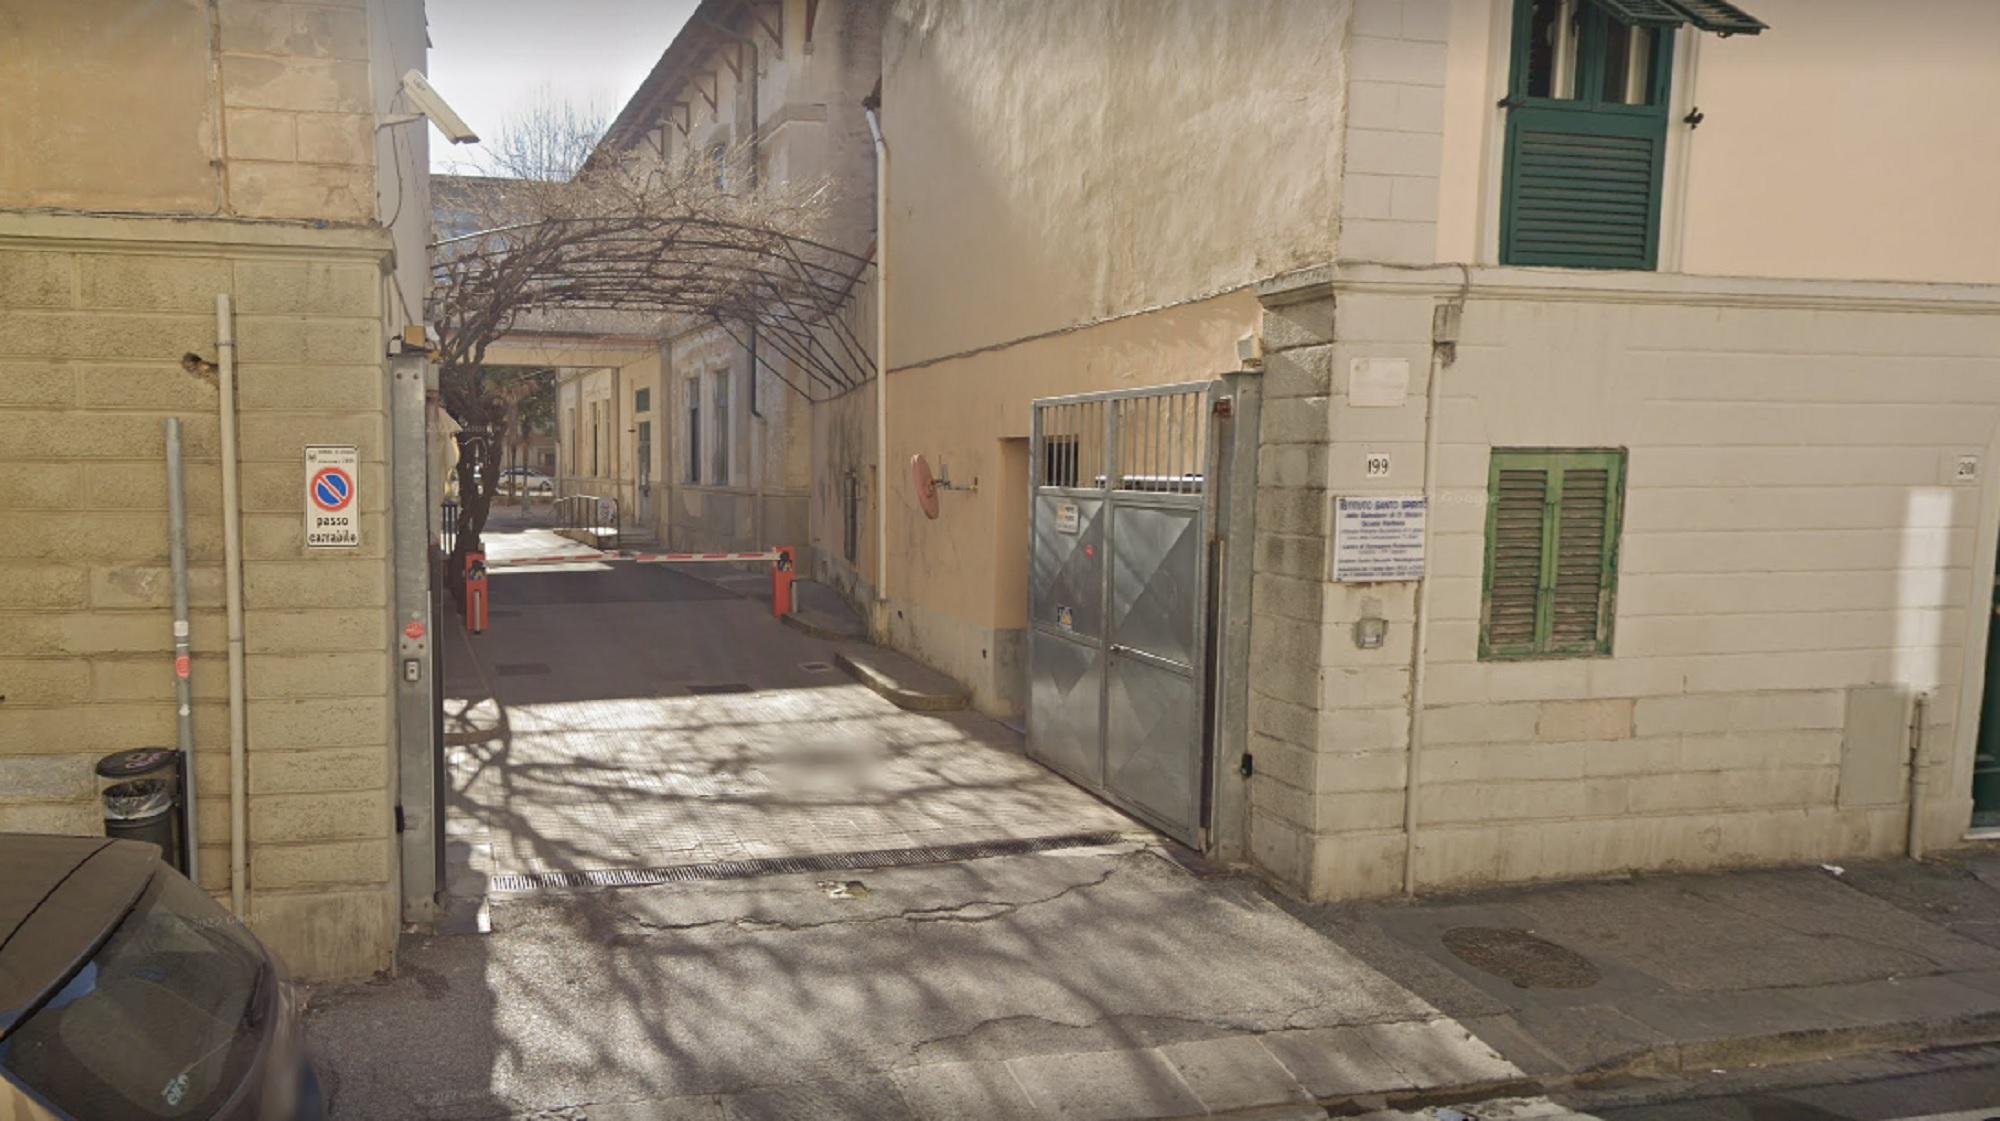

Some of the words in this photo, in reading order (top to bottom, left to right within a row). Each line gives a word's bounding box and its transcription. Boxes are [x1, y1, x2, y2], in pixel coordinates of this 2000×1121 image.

[1368, 458, 1388, 474] 199
[1375, 500, 1399, 510] SANTO
[316, 517, 349, 528] passo
[308, 529, 356, 543] carrabile
